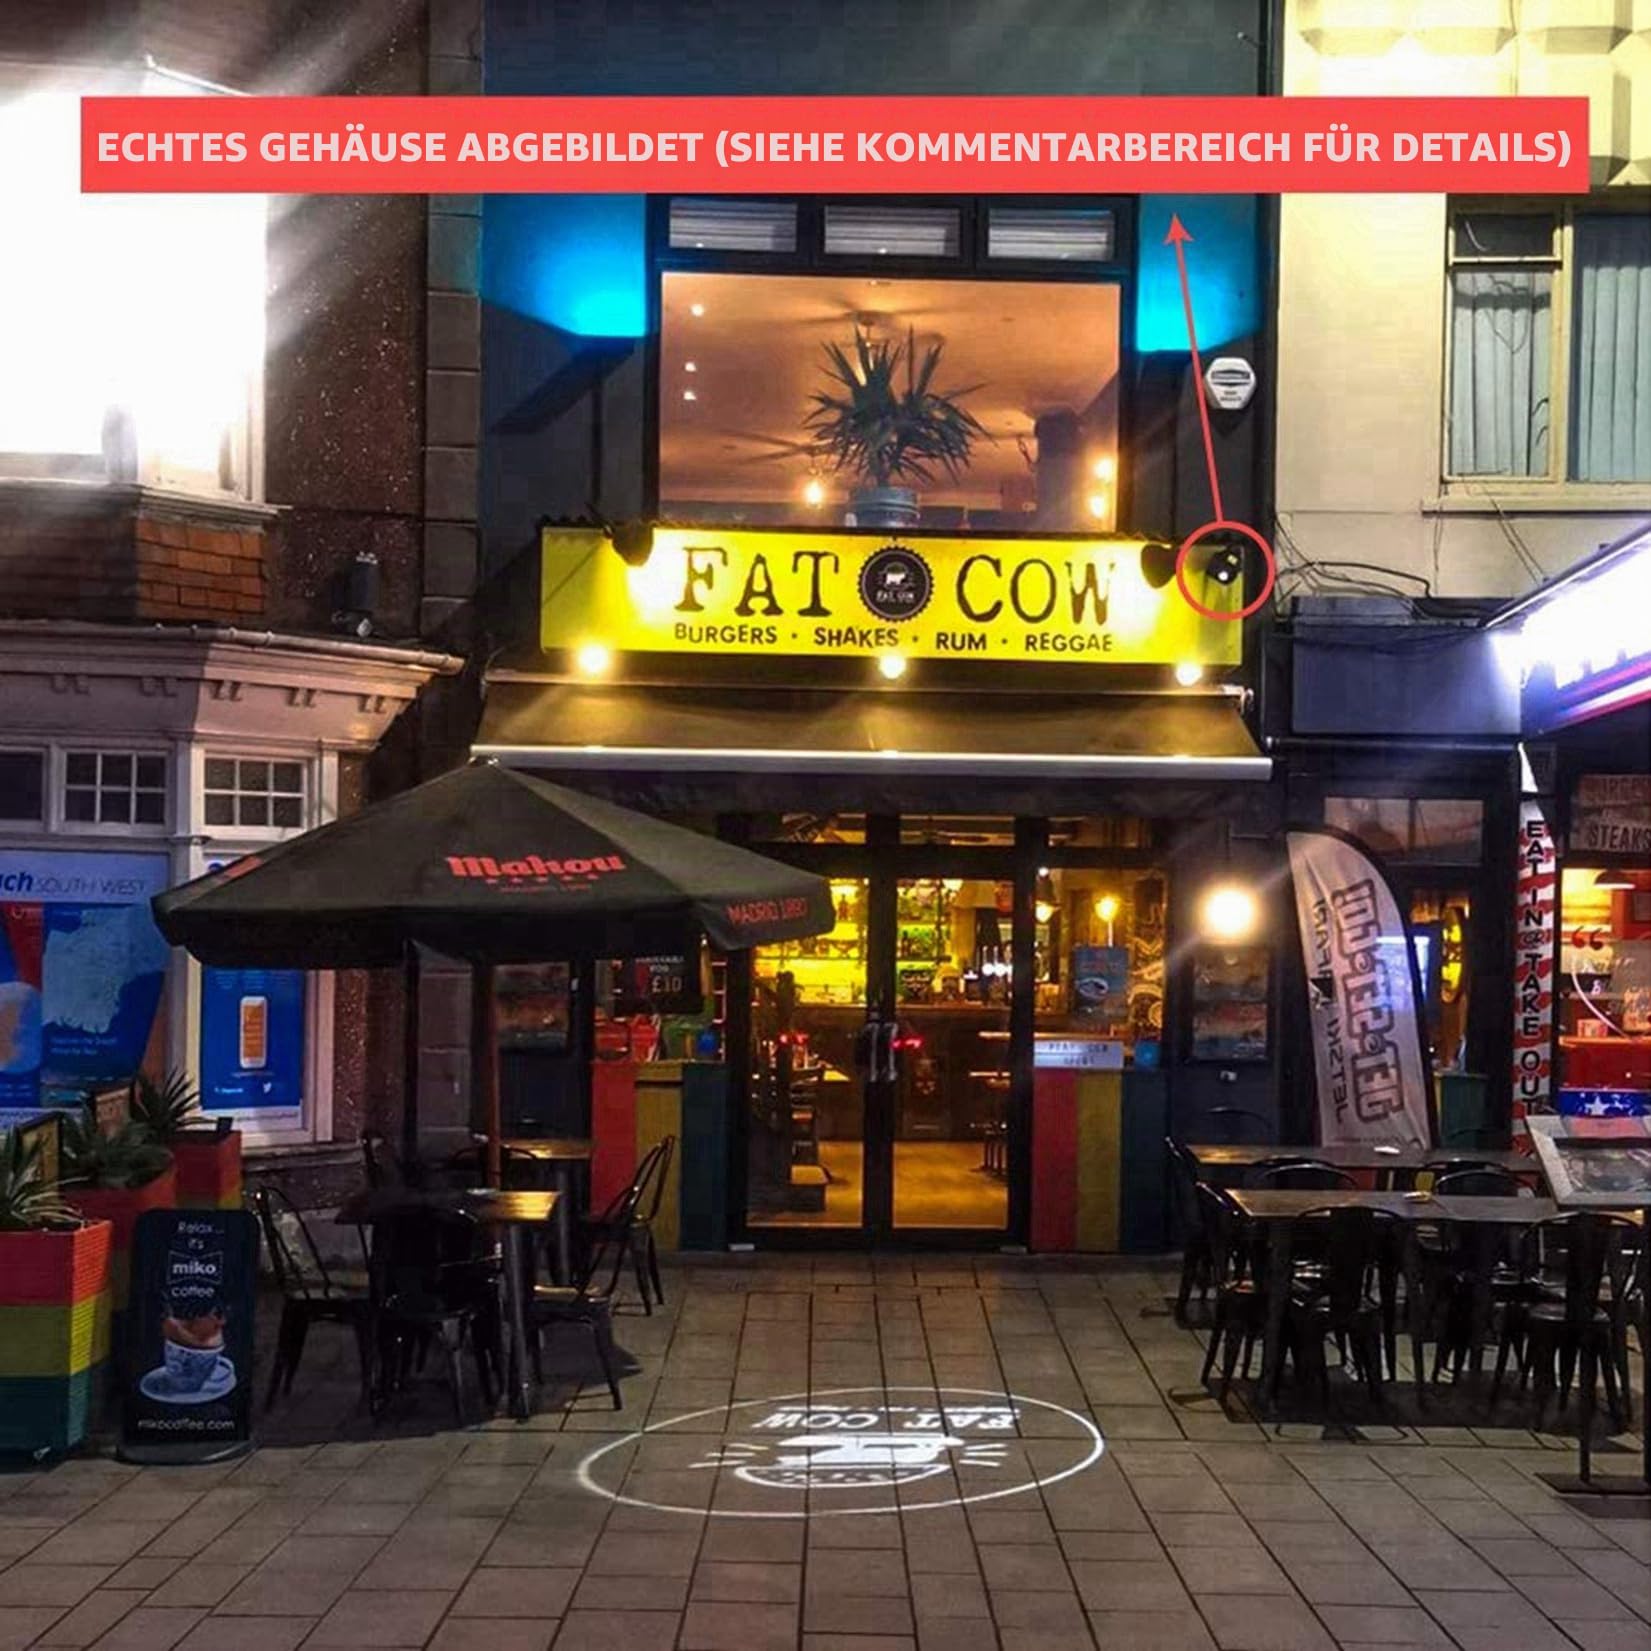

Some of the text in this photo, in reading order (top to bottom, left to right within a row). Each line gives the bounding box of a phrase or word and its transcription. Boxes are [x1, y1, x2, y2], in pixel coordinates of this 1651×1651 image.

[674, 546, 1115, 626] FAT COW
[674, 622, 1113, 653] BURGERS SHAKES RUM REGGAE
[1526, 820, 1545, 876] EAT
[445, 854, 627, 877] Mahou
[0, 871, 34, 893] ch
[1524, 888, 1543, 927] IN
[1522, 953, 1542, 1036] TAKE
[172, 1261, 217, 1275] miko
[171, 1286, 215, 1298] coffee
[752, 1412, 1021, 1430] FAT COW
